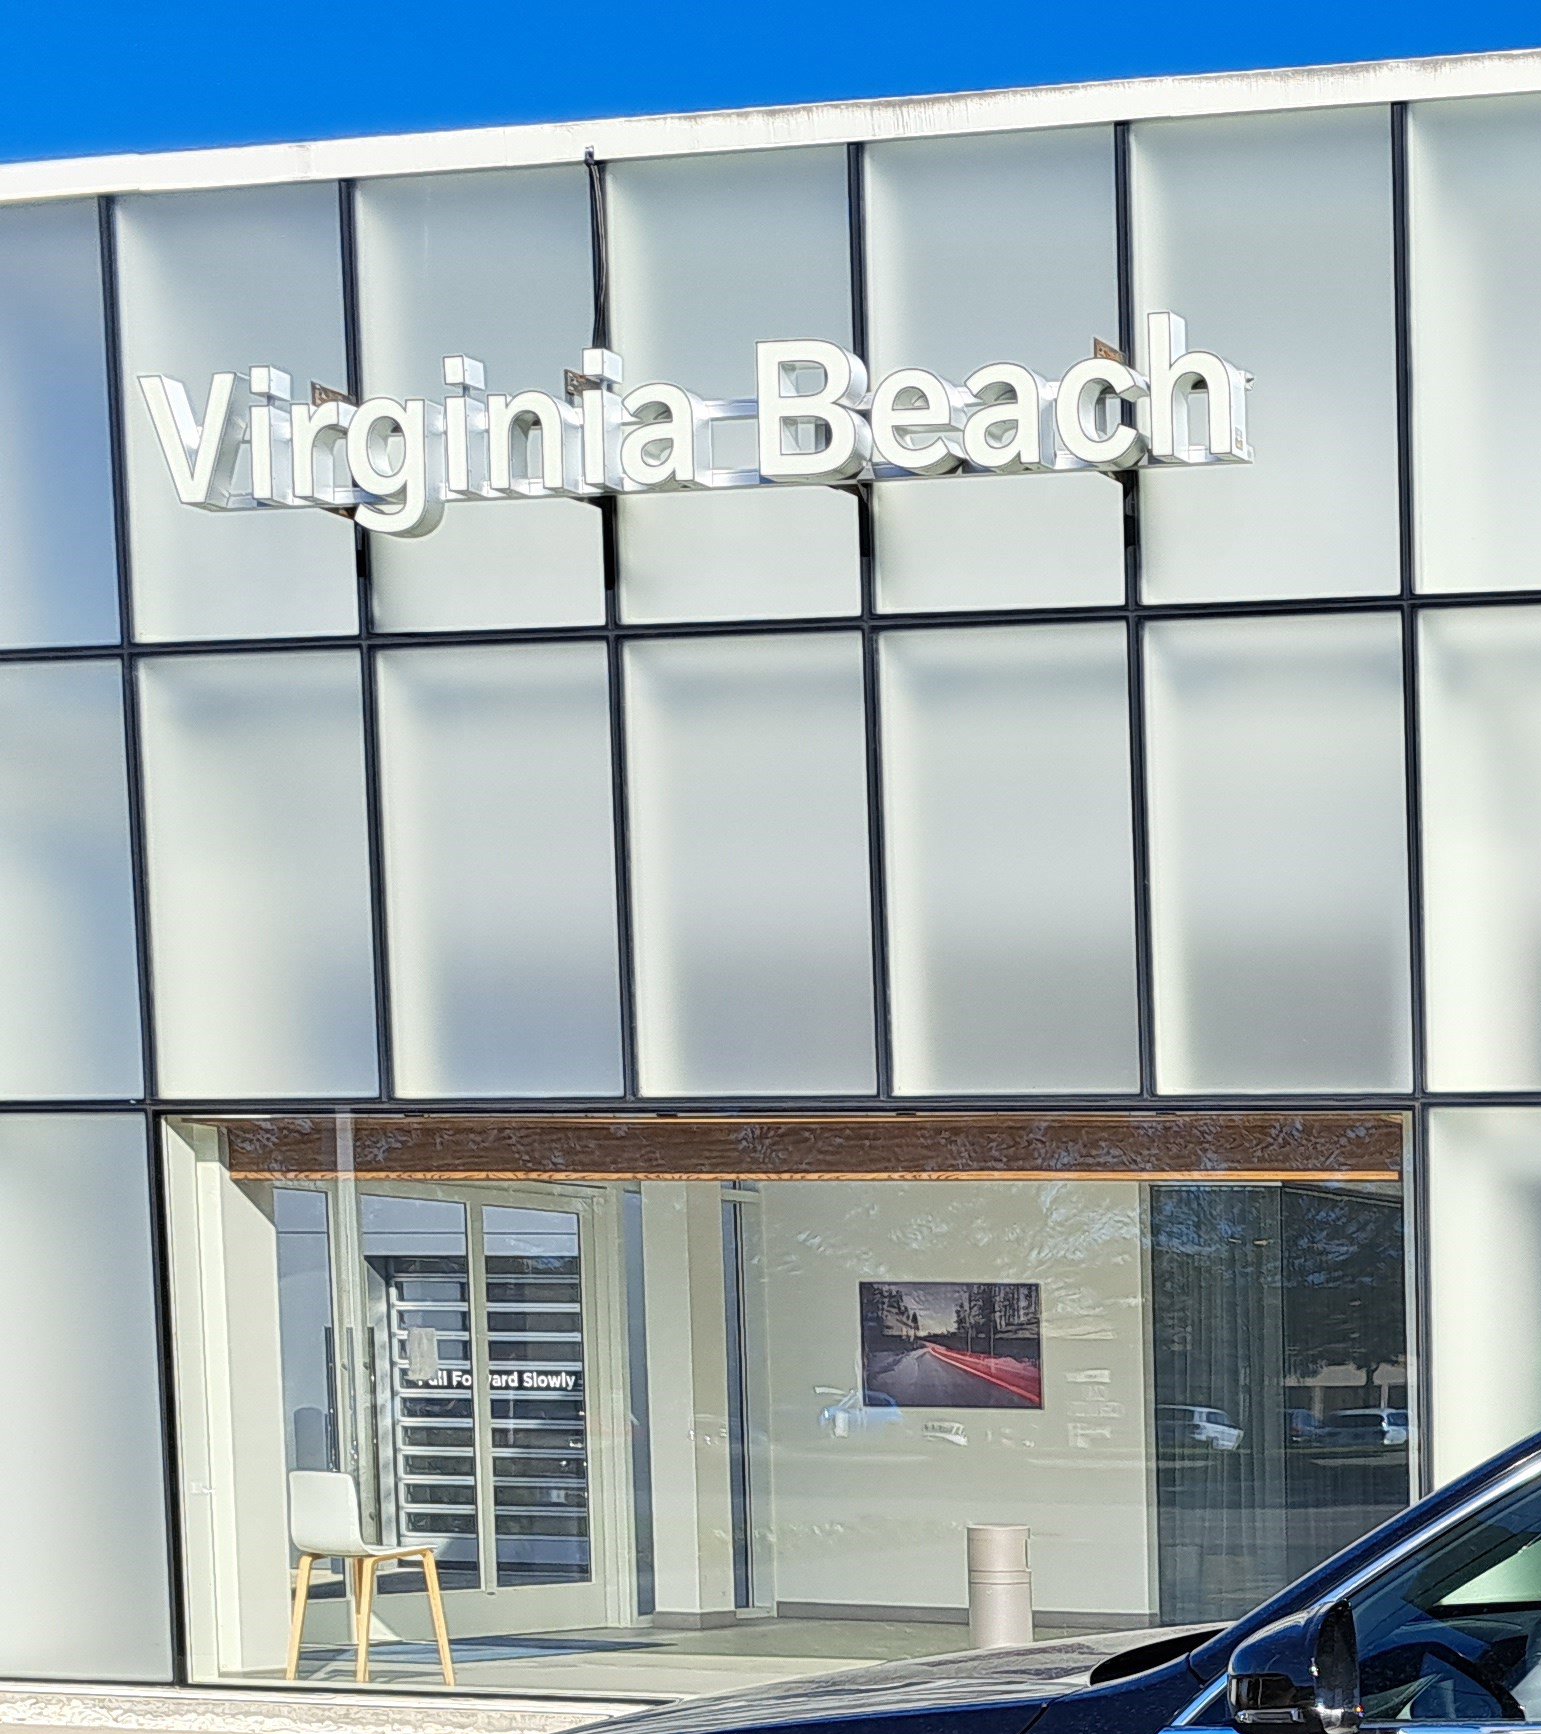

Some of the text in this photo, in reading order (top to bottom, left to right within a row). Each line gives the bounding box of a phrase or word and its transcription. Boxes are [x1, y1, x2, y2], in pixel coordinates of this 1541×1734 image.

[138, 311, 1252, 536] Virginia Beach
[522, 1371, 576, 1390] Slowly
